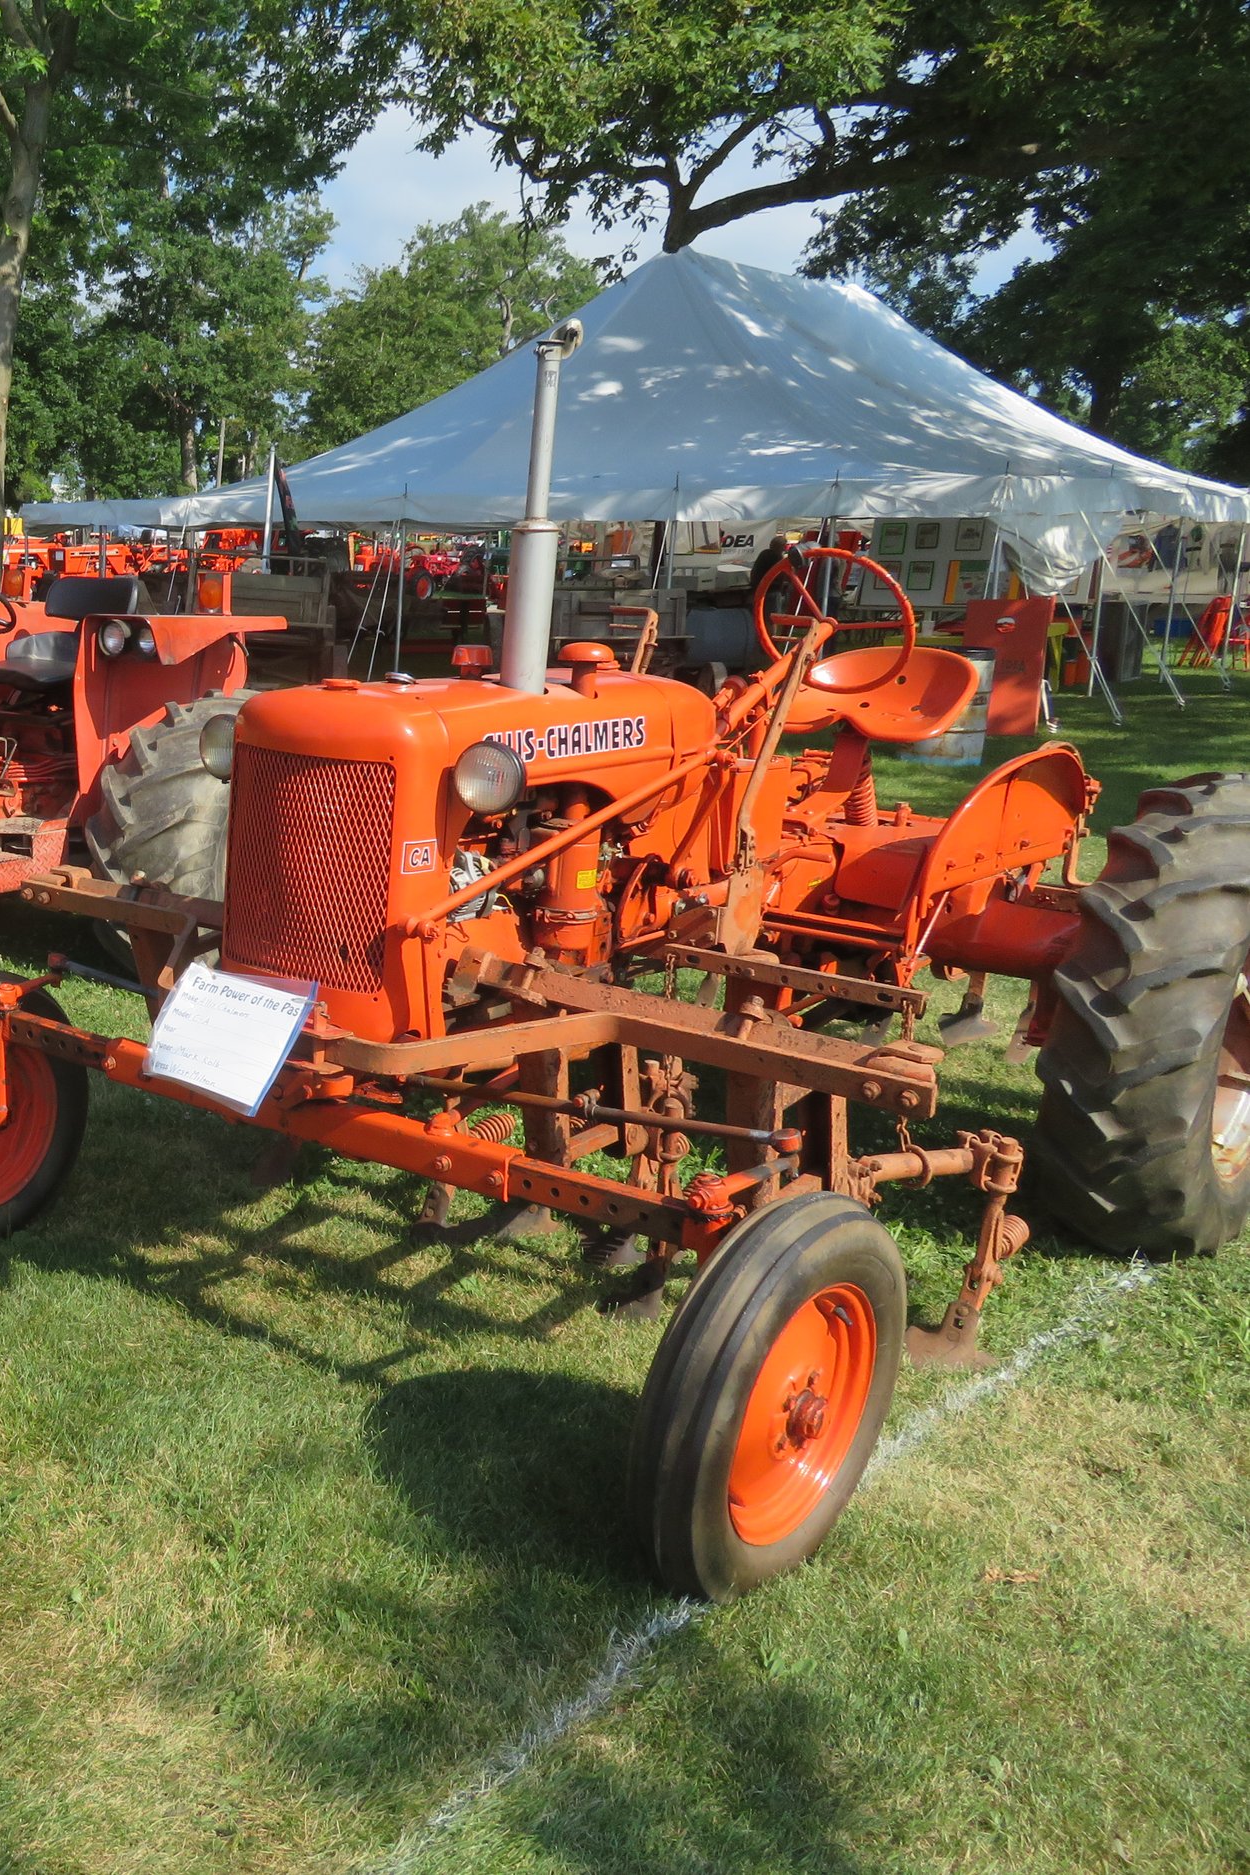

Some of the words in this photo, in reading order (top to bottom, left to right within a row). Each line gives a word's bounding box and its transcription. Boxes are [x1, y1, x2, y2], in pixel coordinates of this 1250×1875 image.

[483, 716, 645, 762] IS-CHALMERS
[410, 847, 431, 867] CA
[192, 976, 219, 993] Farm
[220, 985, 250, 1002] Power
[251, 995, 263, 1006] of
[263, 998, 279, 1011] the
